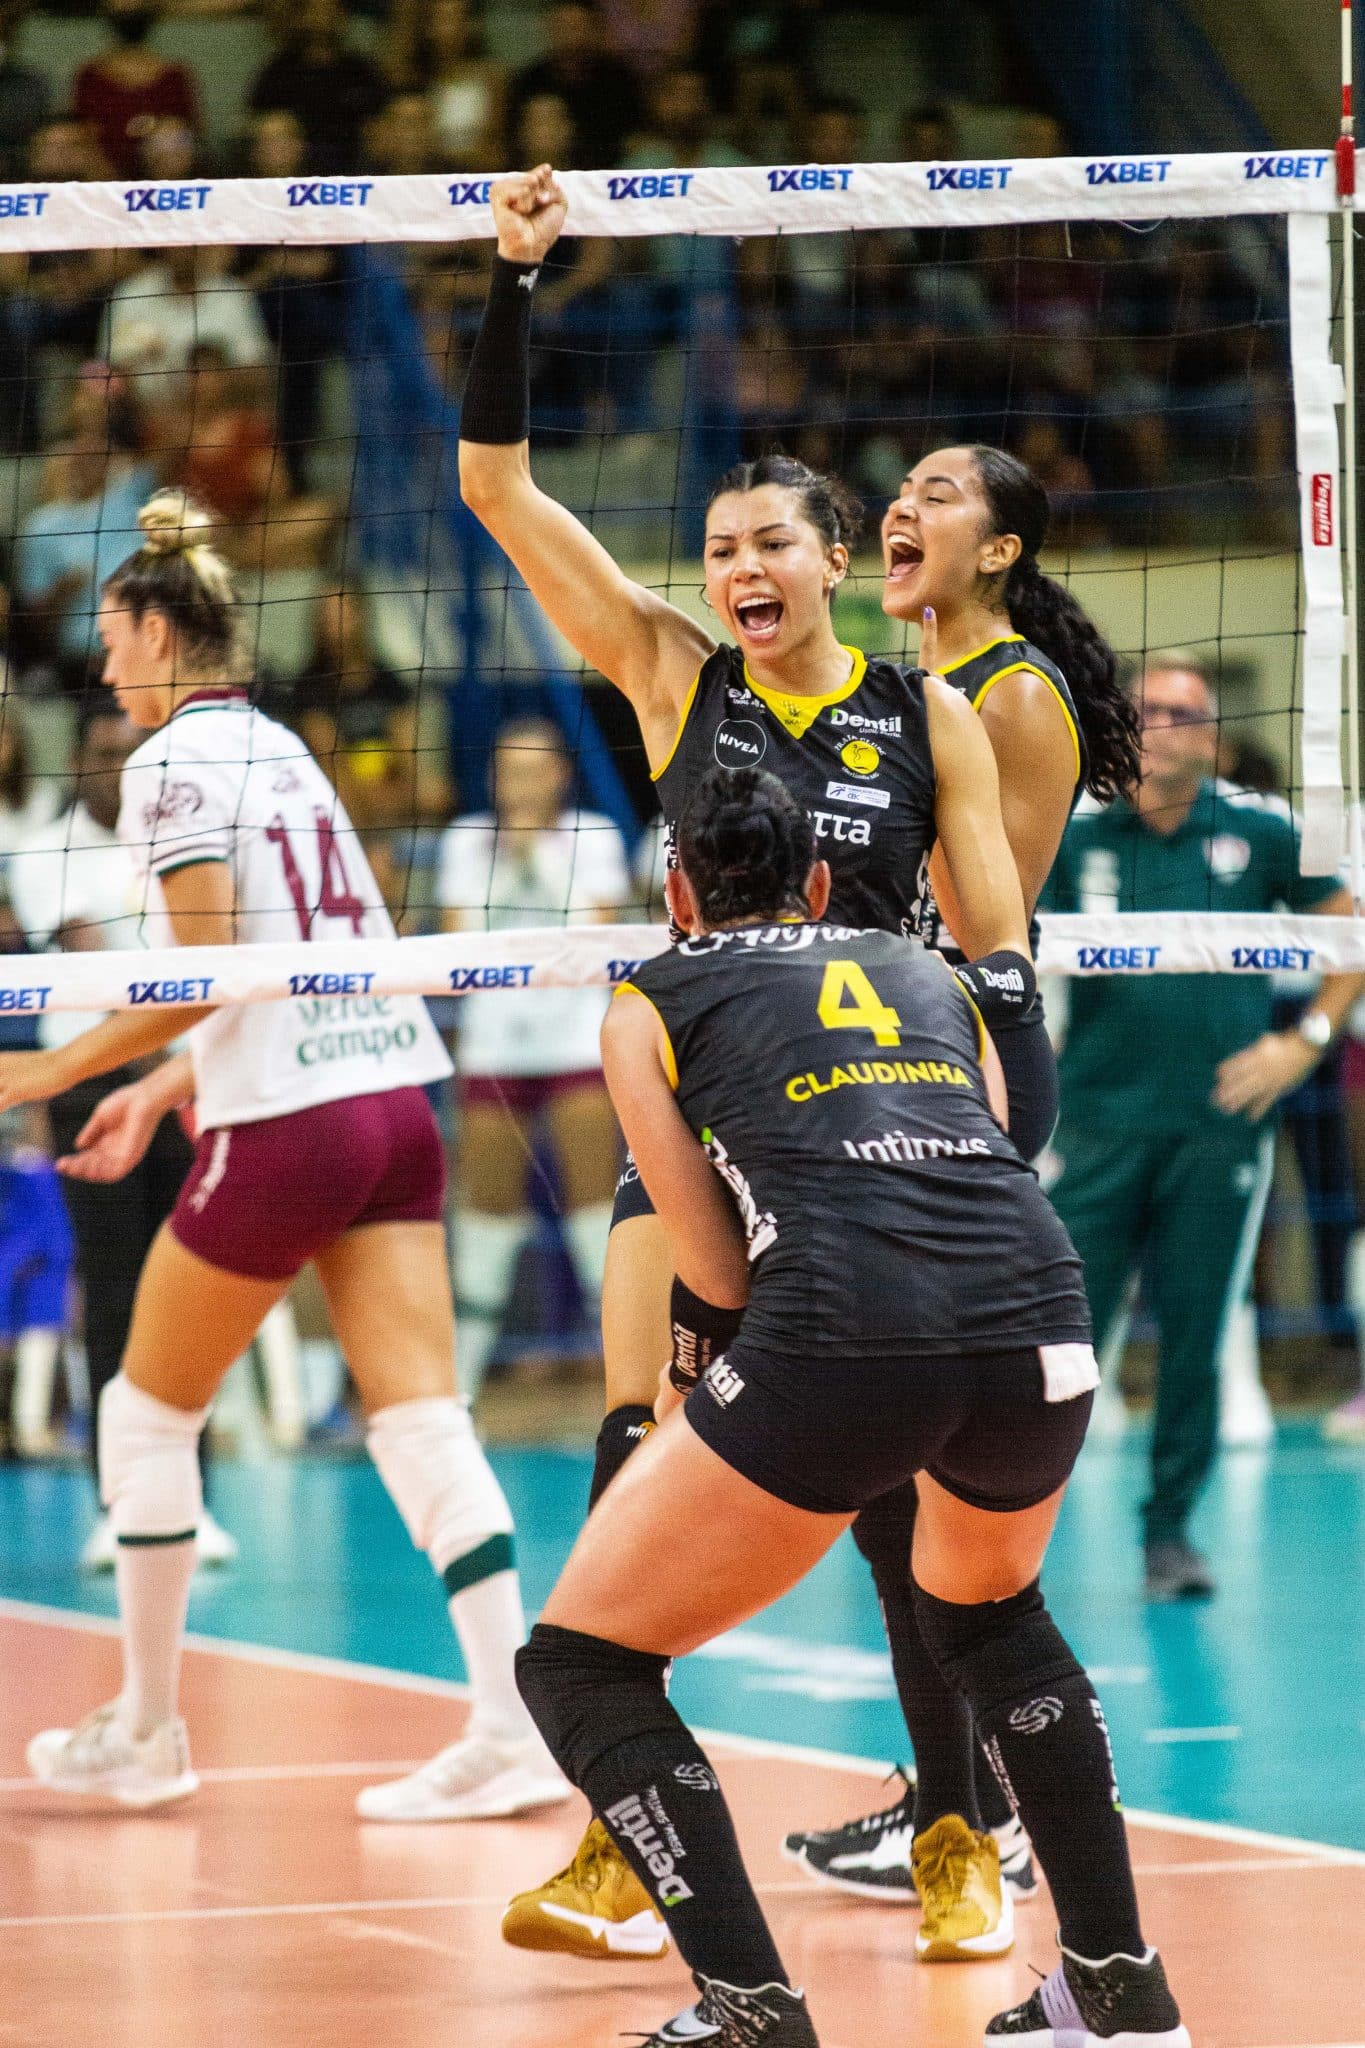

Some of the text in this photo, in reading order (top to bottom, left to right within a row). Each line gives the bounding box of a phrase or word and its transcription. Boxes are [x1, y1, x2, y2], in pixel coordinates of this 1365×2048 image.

[926, 167, 1012, 190] 1XBET
[1086, 161, 1171, 185] 1XBET
[1244, 157, 1328, 179] 1XBET
[608, 175, 694, 200] 1XBET
[767, 169, 852, 192] 1XBET
[0, 193, 49, 218] BET
[125, 187, 212, 212] 1XBET
[287, 183, 373, 206] 1XBET
[831, 708, 902, 733] Dentil
[718, 732, 759, 755] NIVEA
[265, 804, 365, 941] 14
[1077, 946, 1161, 970] 1XBET
[1231, 947, 1315, 971] 1XBET
[289, 973, 374, 995] 1XBET
[450, 965, 534, 989] 1XBET
[0, 988, 52, 1010] BET
[128, 979, 214, 1003] 1XBET
[817, 960, 902, 1047] 4
[297, 1022, 417, 1068] campo
[785, 1061, 973, 1102] CLAUDINHA
[603, 1794, 695, 1907] Dentil
